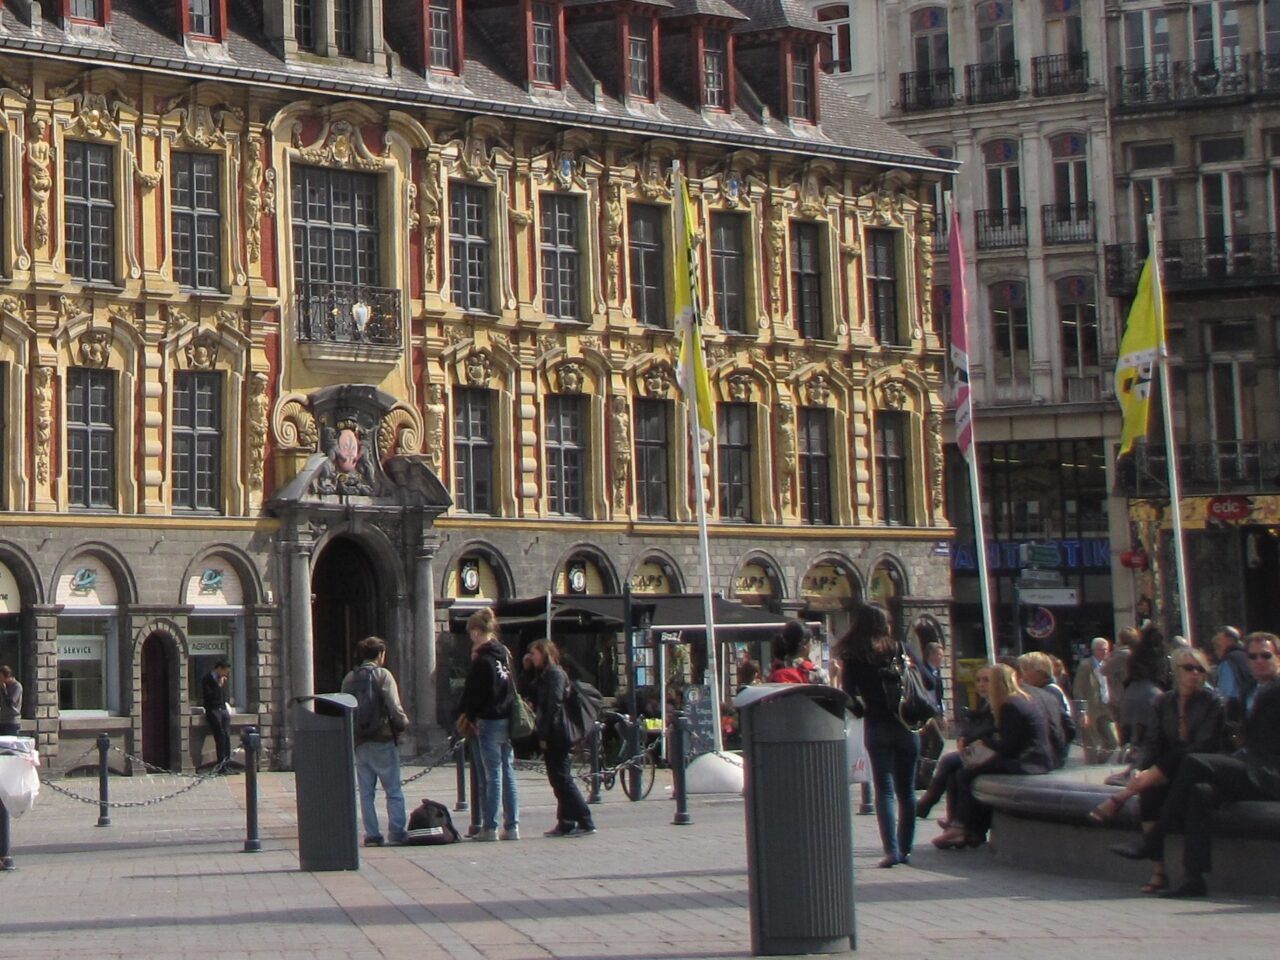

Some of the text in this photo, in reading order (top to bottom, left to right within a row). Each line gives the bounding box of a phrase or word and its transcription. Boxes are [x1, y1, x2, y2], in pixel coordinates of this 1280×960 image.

[1212, 499, 1241, 513] edc
[63, 645, 91, 654] SERVICE
[191, 642, 224, 650] AGRICOLE
